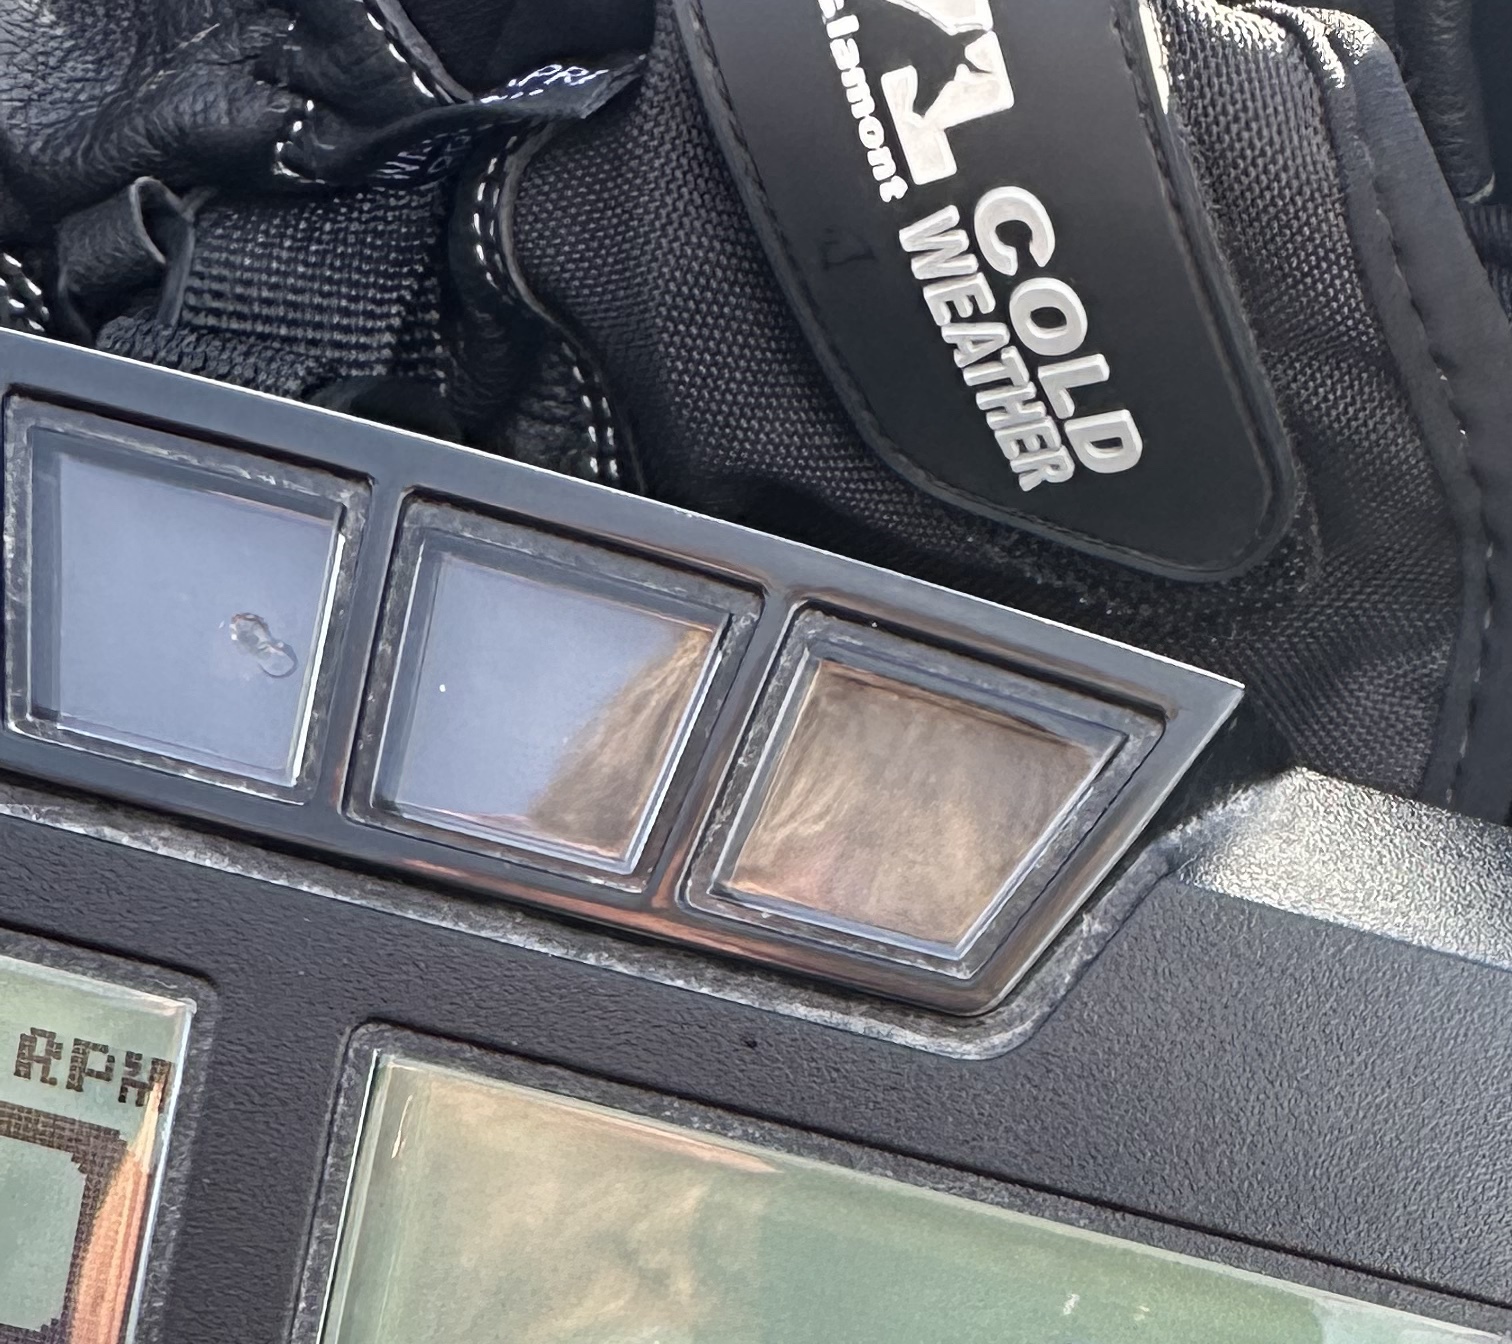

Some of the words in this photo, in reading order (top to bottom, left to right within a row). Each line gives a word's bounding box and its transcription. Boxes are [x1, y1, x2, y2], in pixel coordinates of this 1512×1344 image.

[899, 205, 1076, 492] WEATHER
[973, 186, 1143, 474] COLD
[14, 1027, 172, 1113] RPM
